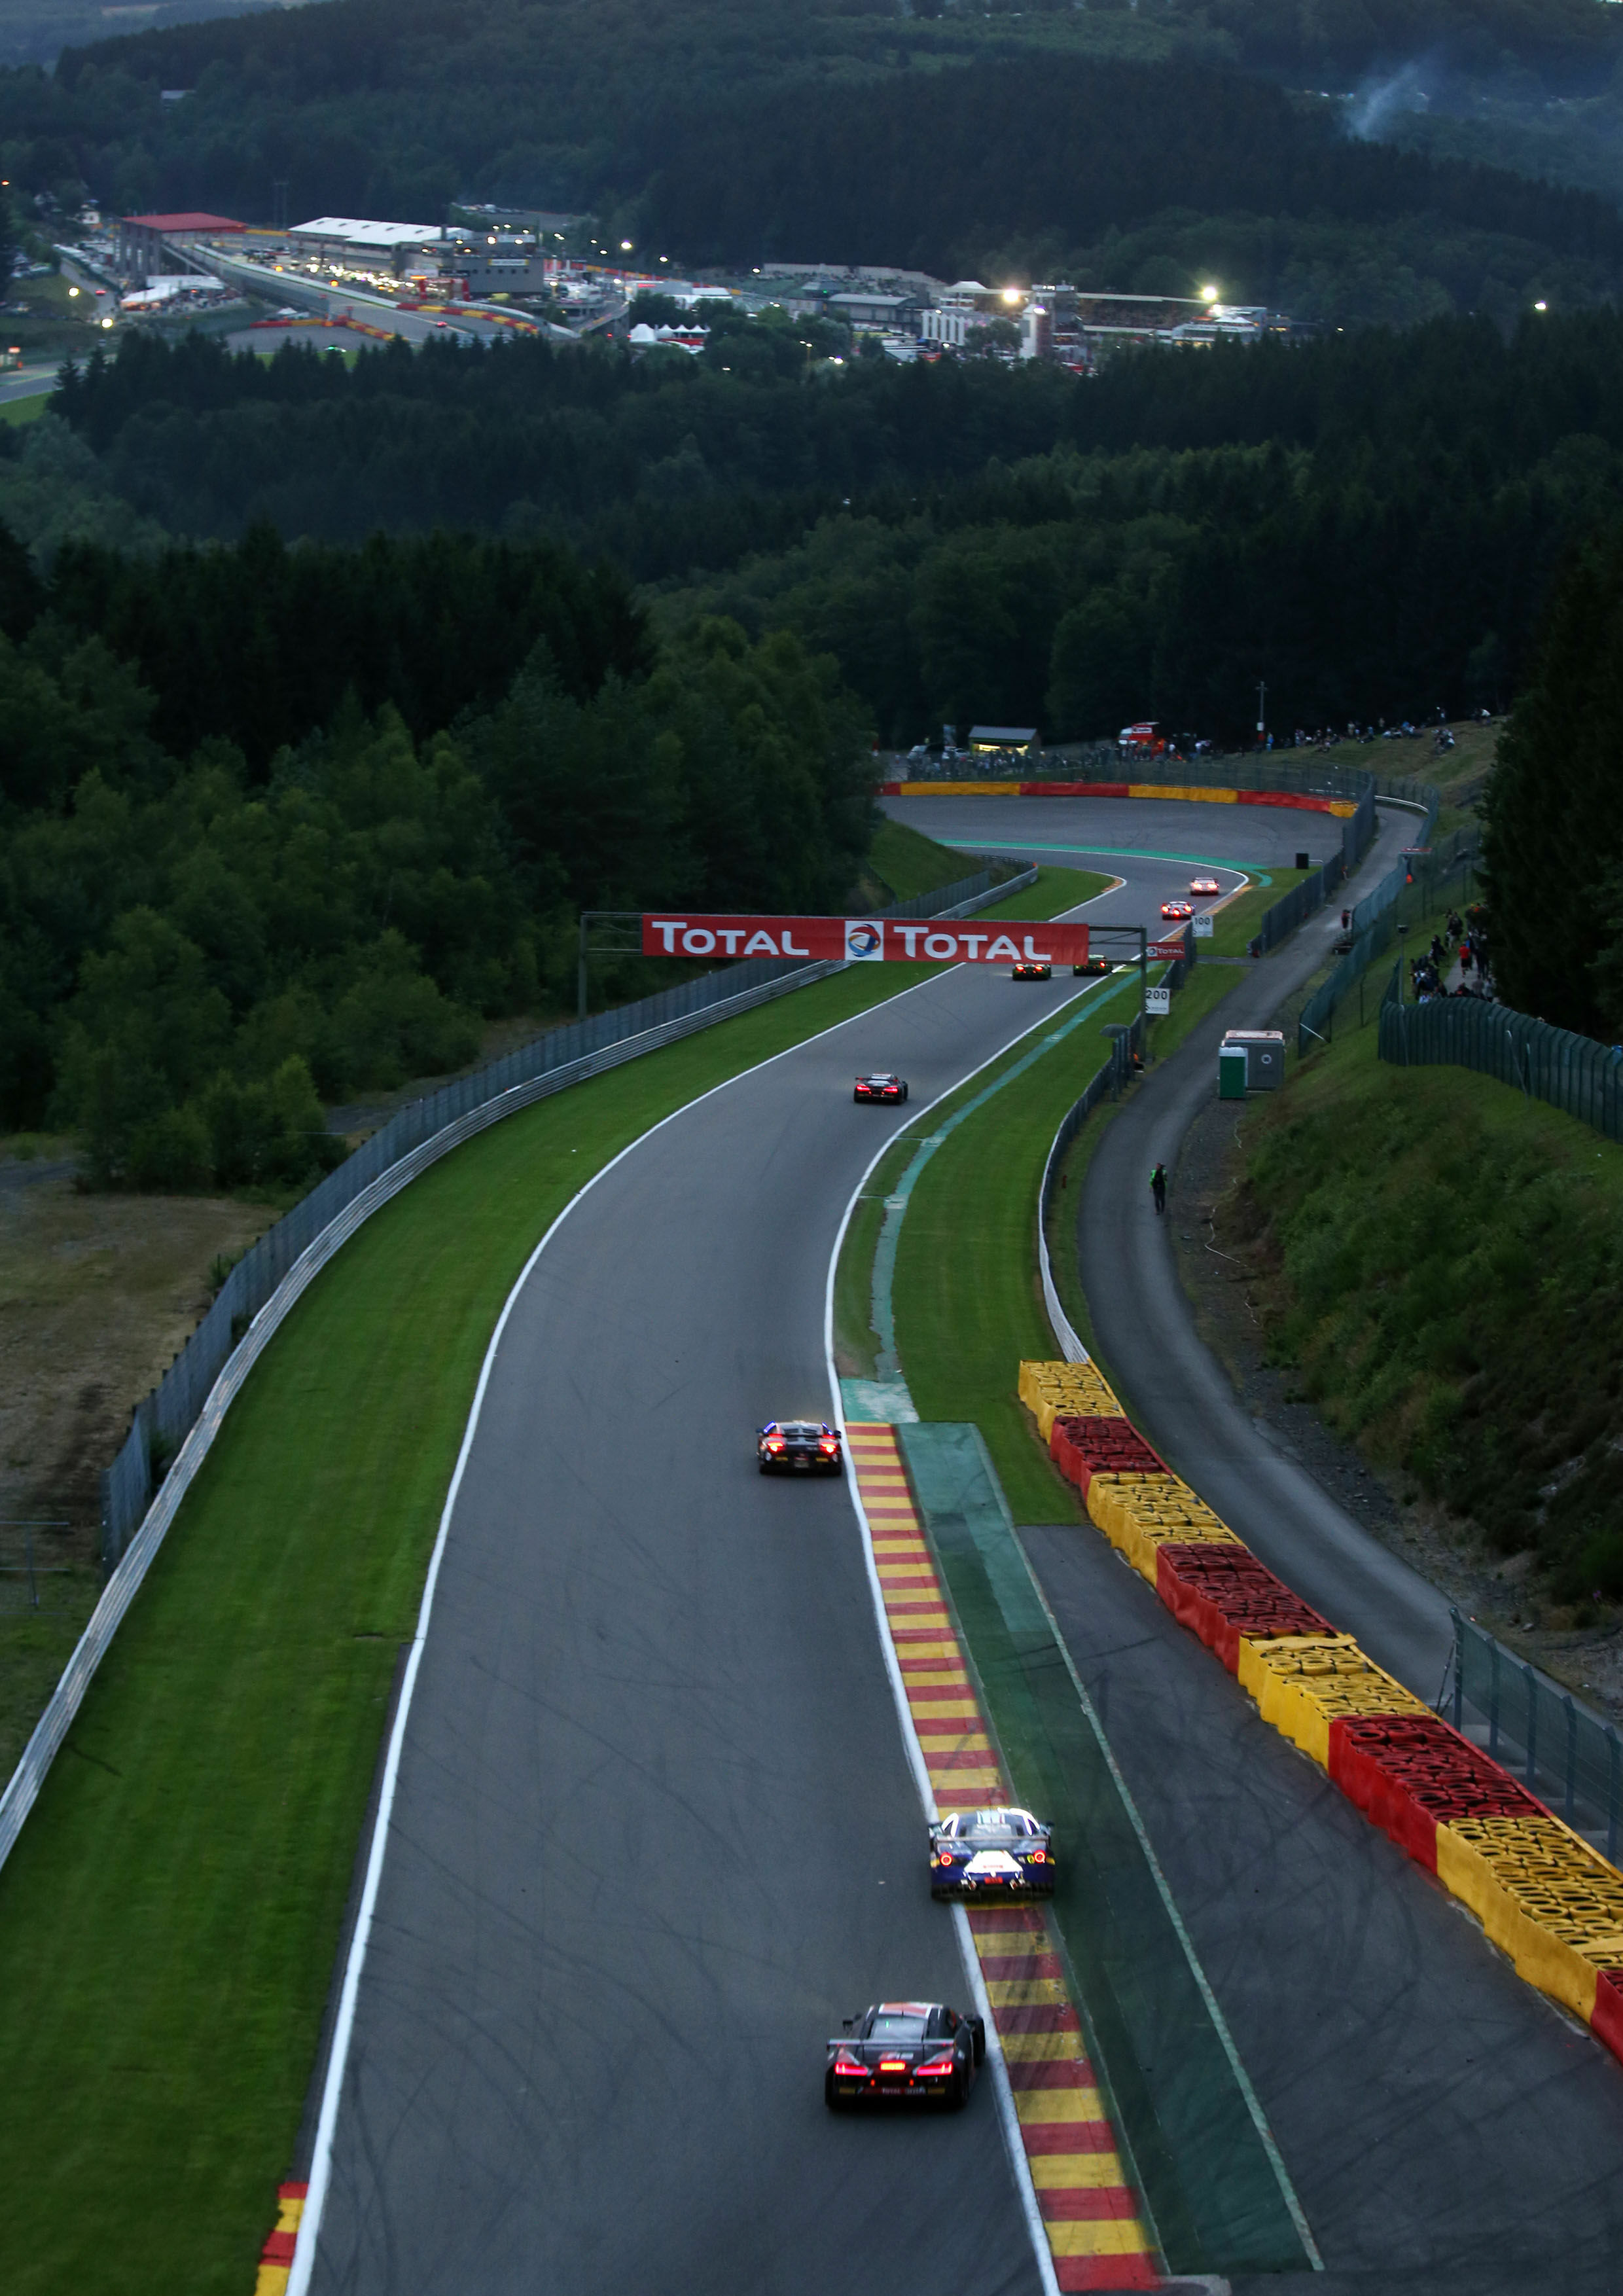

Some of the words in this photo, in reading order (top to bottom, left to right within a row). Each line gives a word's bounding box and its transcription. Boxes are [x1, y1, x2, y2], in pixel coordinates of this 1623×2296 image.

[1194, 917, 1211, 925] 100
[652, 922, 810, 956] TOTAL
[893, 926, 1052, 961] TOTAL
[1146, 990, 1168, 999] 200
